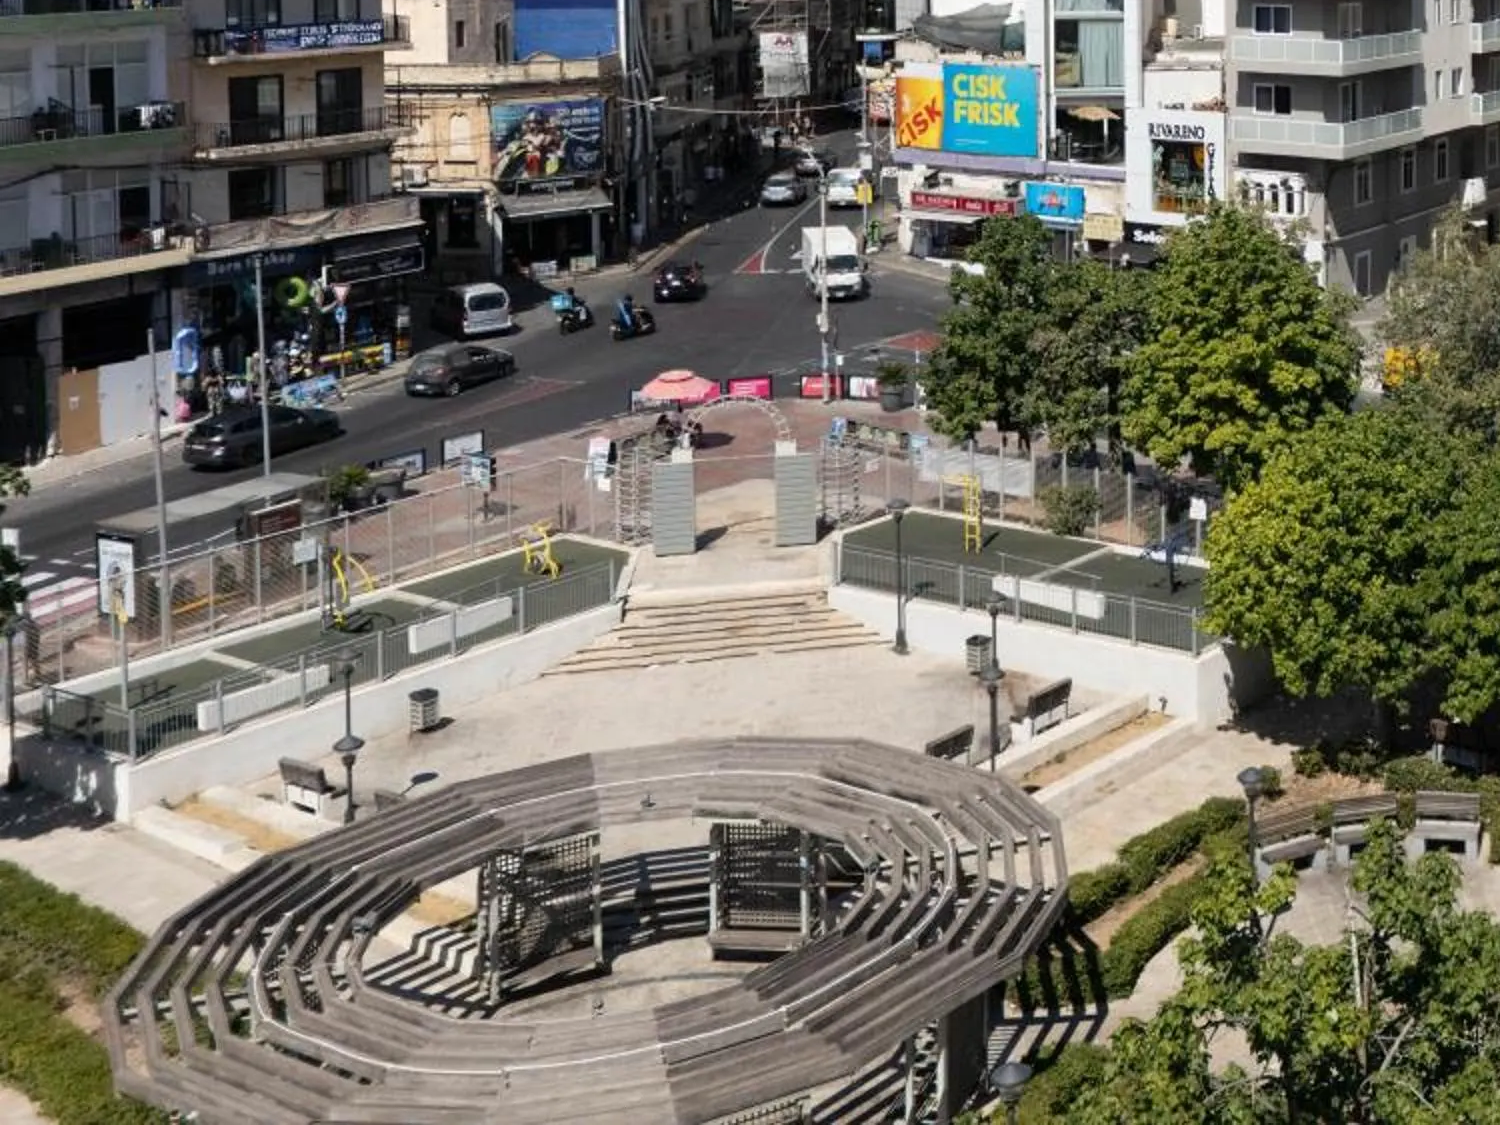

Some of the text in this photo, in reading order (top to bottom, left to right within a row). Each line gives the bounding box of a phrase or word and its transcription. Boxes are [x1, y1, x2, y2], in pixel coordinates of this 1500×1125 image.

[952, 73, 1007, 100] CISK
[899, 96, 943, 147] CISK
[953, 99, 1020, 128] FRISK
